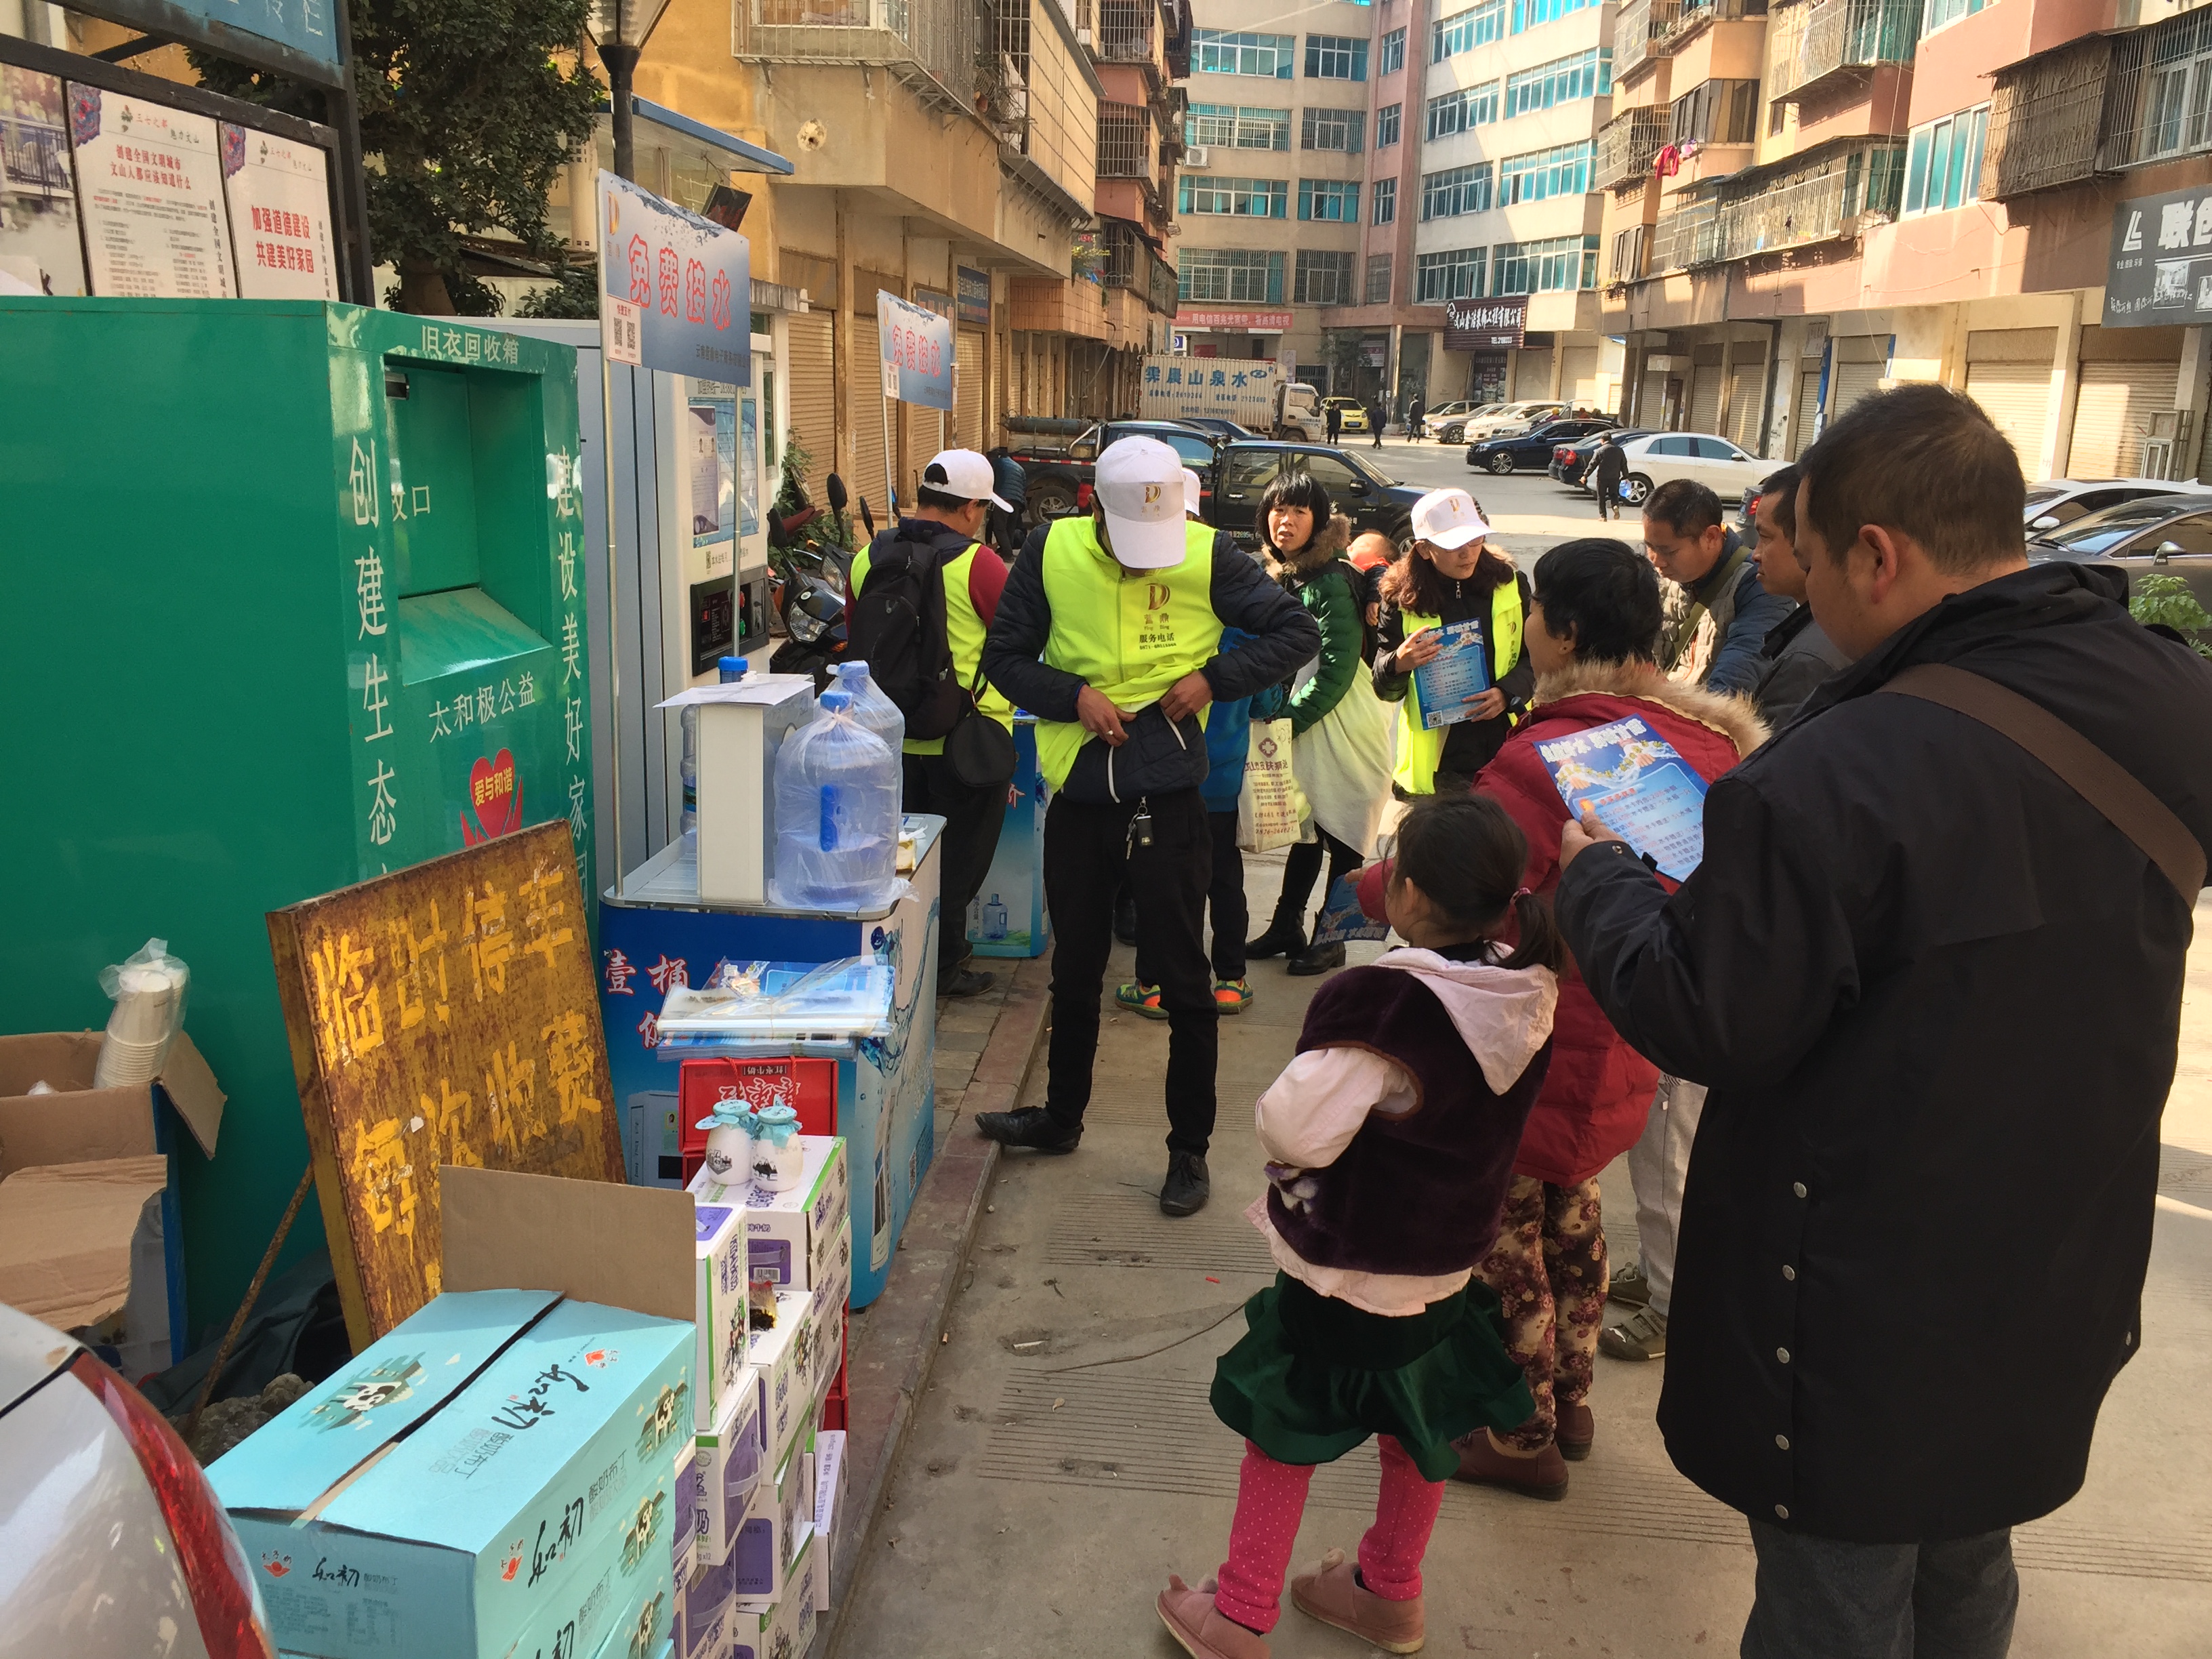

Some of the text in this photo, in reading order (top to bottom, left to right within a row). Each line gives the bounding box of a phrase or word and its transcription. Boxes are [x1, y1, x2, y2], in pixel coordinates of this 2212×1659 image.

[110, 161, 192, 190] 文山人都应该知道什么
[117, 144, 181, 171] 创建全国文明城市
[251, 205, 310, 239] 加强道德建设
[256, 241, 314, 273] 共建美好家园
[628, 233, 731, 331] 免费接水
[421, 325, 520, 366] 旧衣回收箱
[892, 324, 941, 378] 免费接水
[348, 435, 397, 873] 创建生态
[1139, 632, 1174, 643] 服务电话
[428, 671, 536, 744] 太和极公益
[474, 766, 514, 806] 爱与和谐
[311, 857, 574, 1071] 临时停车
[455, 1432, 514, 1479] 酸奶布丁
[588, 1449, 627, 1504] 酸奶布丁
[579, 1565, 611, 1626] 酸奶布丁
